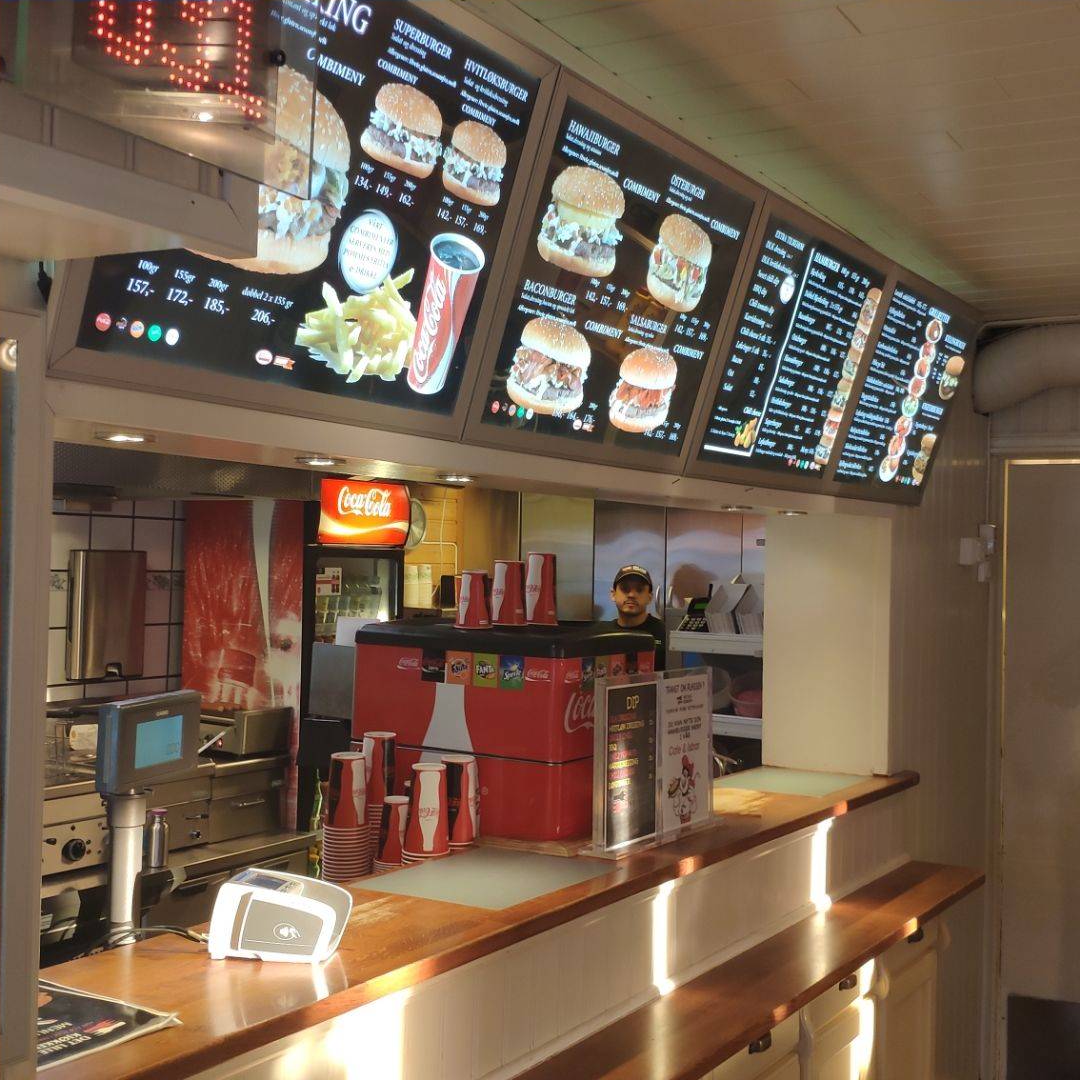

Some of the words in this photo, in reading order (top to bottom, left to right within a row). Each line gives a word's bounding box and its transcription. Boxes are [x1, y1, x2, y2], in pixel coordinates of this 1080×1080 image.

[392, 17, 453, 60] SUPERBURGER
[304, 45, 366, 88] CMBIMENY
[376, 57, 418, 85] COMBIMENY
[463, 57, 529, 102] HVITLØKSBURGER
[460, 102, 496, 127] COMBIMENY
[567, 118, 621, 156] HAWAIIBURGER
[353, 174, 373, 191] 134,-
[375, 183, 393, 198] 149,-
[398, 191, 415, 207] 162,-
[622, 175, 660, 204] COMBIMENY
[669, 173, 705, 200] OSTEBURGER
[436, 207, 453, 222] 142,-
[454, 214, 469, 229] 157,-
[472, 221, 488, 236] 169,-
[709, 217, 740, 241] COMBIMENY
[136, 258, 160, 275] 100gr
[172, 268, 196, 285] 155gr
[206, 277, 230, 293] 200gr
[241, 286, 263, 300] dobbel
[273, 294, 286, 306] 155
[523, 278, 577, 306] BACONBURGER
[125, 277, 156, 297] 157,-
[165, 286, 195, 307] 172,-
[202, 296, 231, 316] 185,-
[250, 308, 277, 326] 206,-
[584, 318, 623, 340] COMBIMENY
[337, 485, 392, 518] Coca-Cola
[626, 695, 640, 710] DIP
